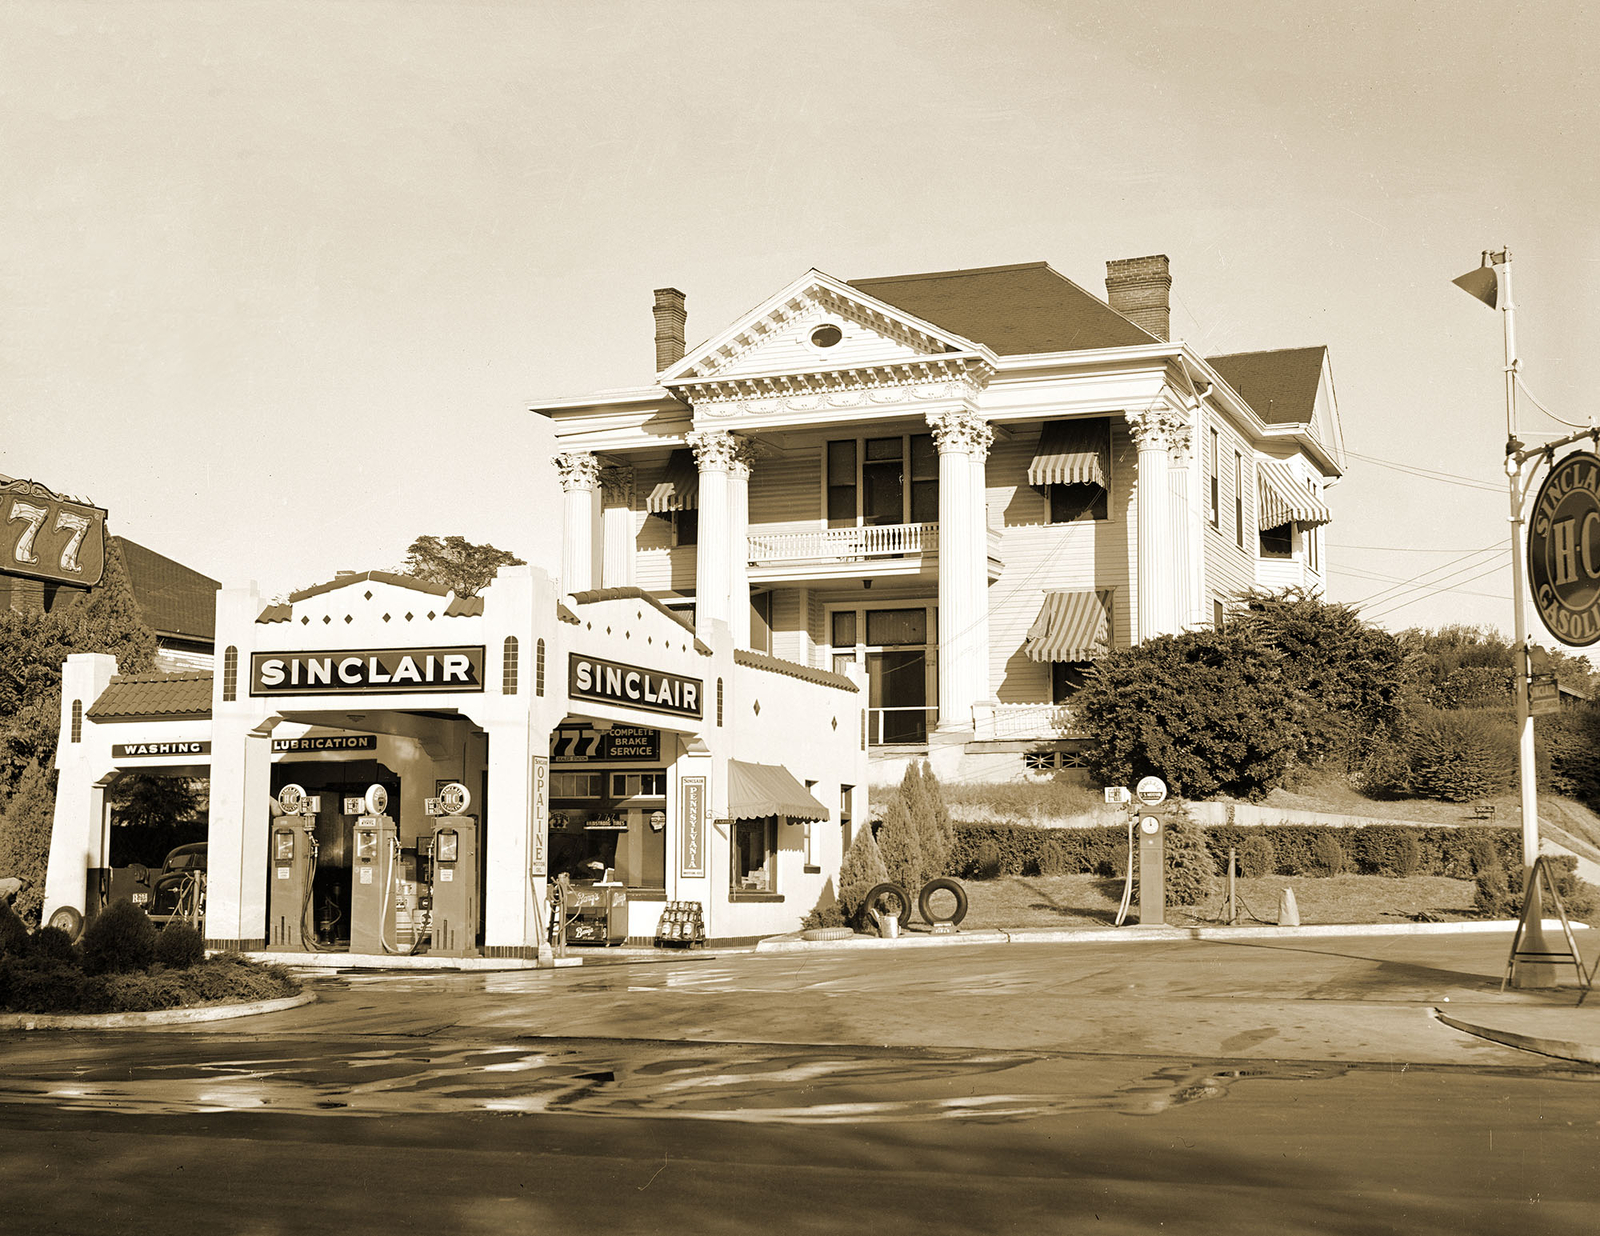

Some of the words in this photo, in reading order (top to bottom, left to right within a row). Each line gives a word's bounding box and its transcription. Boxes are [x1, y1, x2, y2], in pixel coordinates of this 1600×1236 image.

[0, 496, 93, 574] 77
[1539, 582, 1600, 640] GASOLI
[260, 653, 471, 686] SINCLAIR
[576, 661, 697, 710] SINCLAIR
[124, 743, 202, 755] WASHING
[273, 736, 369, 751] LUBRICATION
[609, 728, 654, 737] COMPLETE
[615, 737, 648, 746] BRAKE
[610, 746, 653, 756] SERVICE
[535, 766, 545, 861] OPALINE
[688, 786, 698, 868] PENNSYLVANIA
